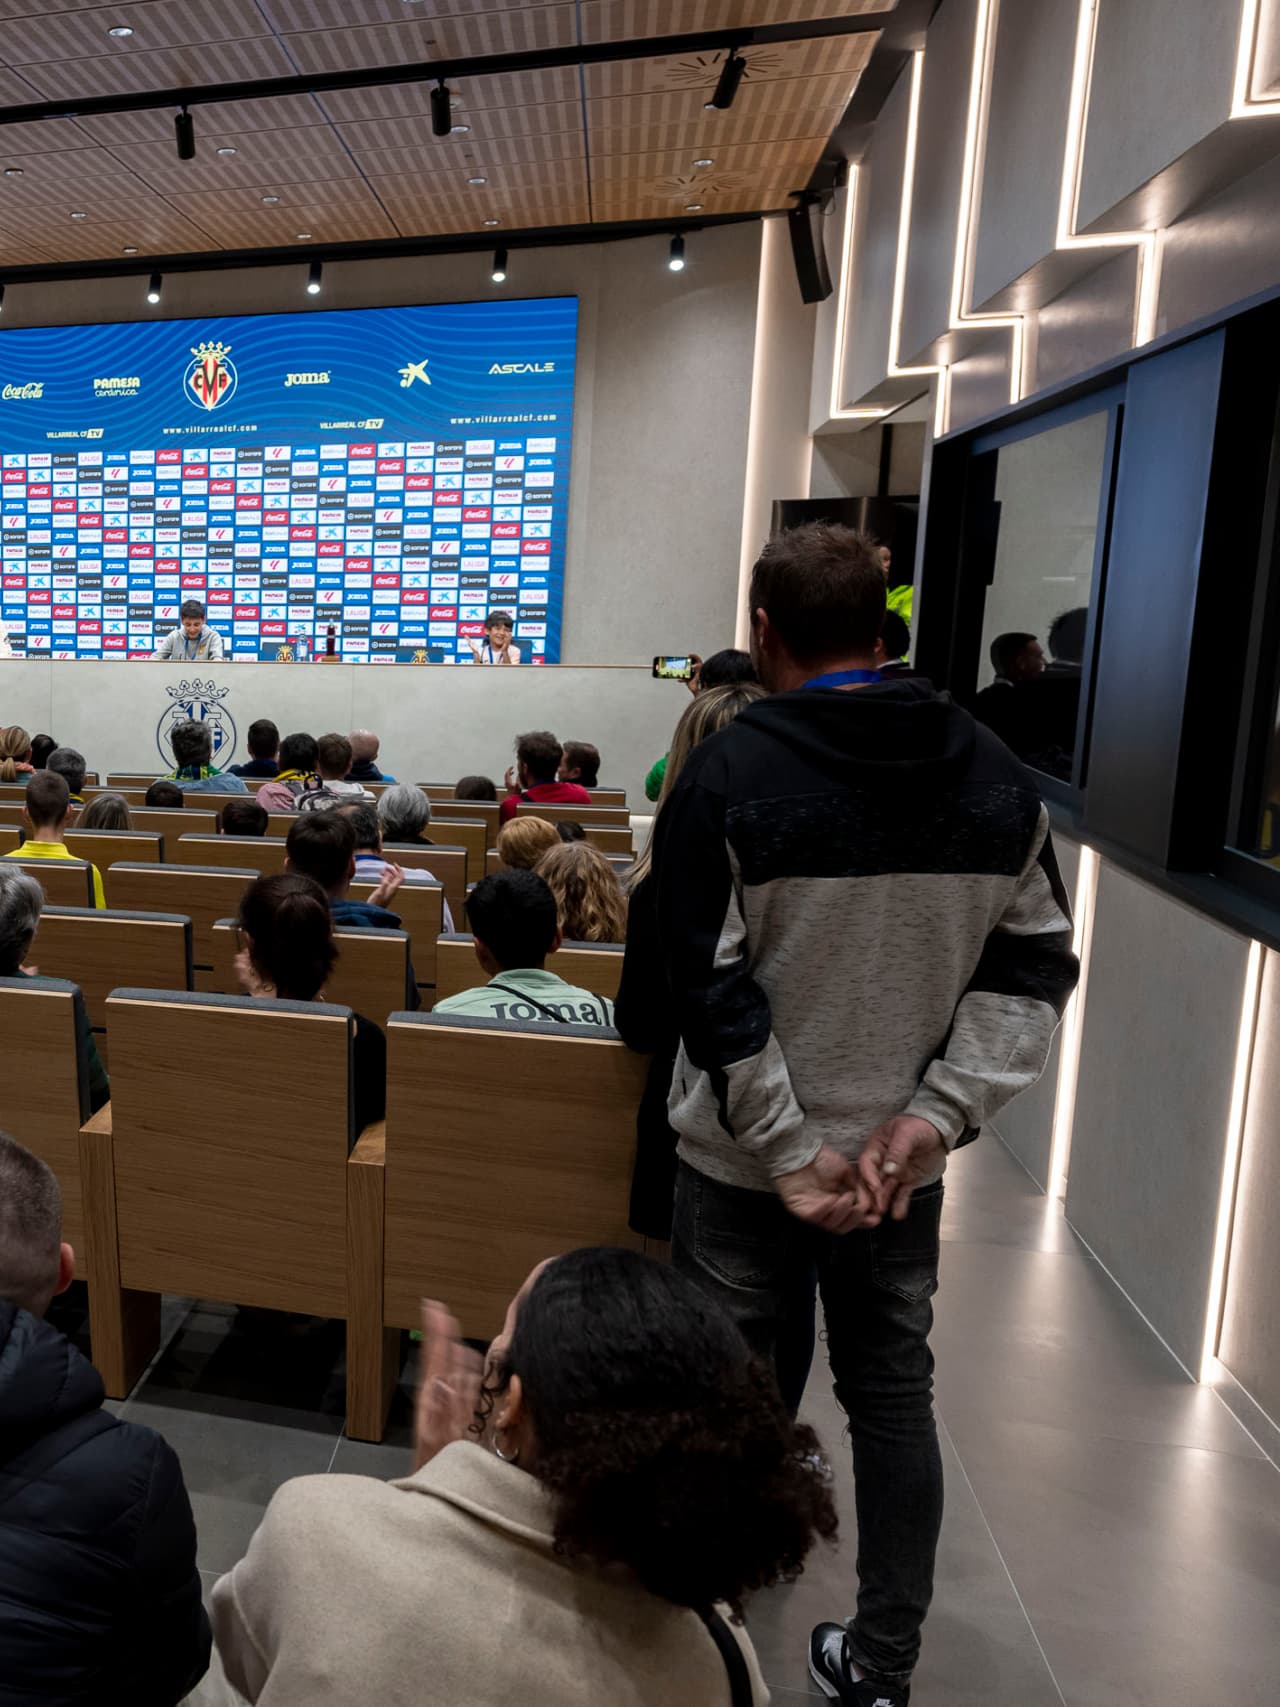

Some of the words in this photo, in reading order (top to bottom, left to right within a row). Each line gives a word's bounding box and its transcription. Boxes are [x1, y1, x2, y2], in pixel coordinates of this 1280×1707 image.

[488, 362, 555, 375] ASCALE
[93, 377, 140, 389] PAMESA
[450, 413, 556, 424] www.villarrealcf.com
[163, 424, 257, 434] www.villarrealcf.com
[320, 421, 356, 429] VILLARREAL
[46, 431, 79, 439] VILLARREAL
